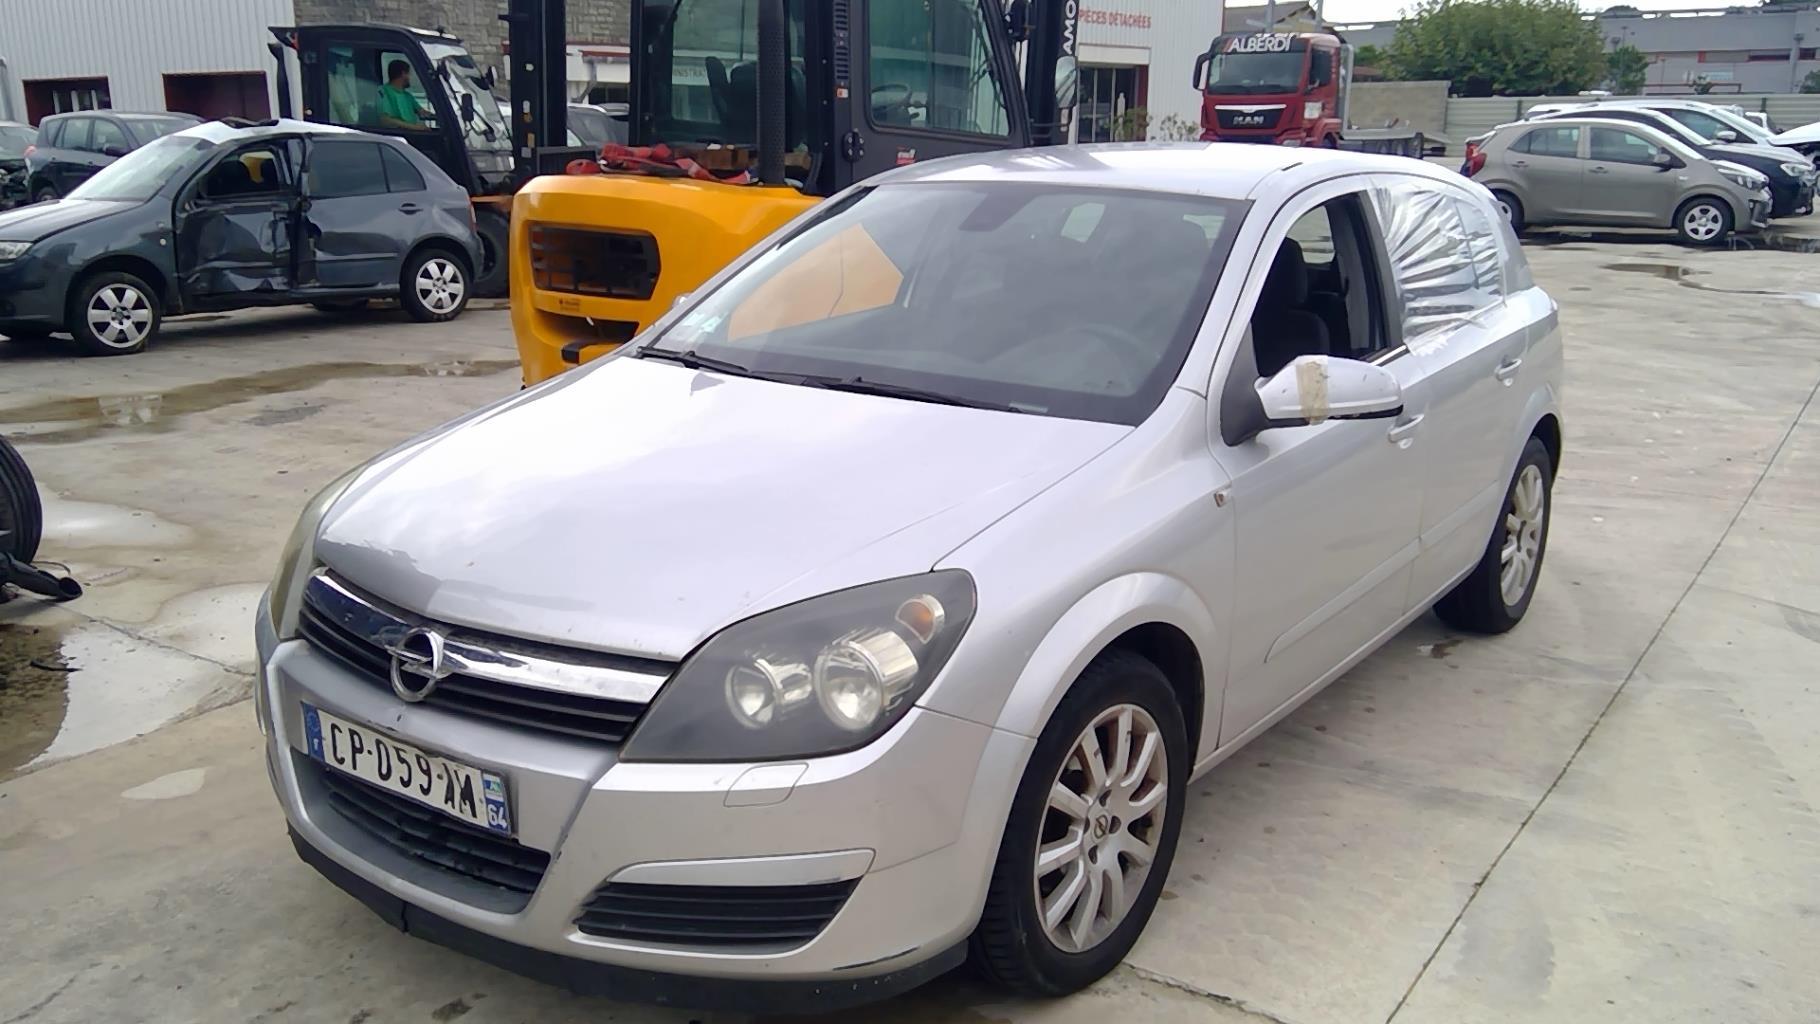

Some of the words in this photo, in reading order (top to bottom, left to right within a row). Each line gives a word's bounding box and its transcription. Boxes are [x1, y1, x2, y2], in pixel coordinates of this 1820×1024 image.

[1228, 36, 1291, 52] ALBERDI
[1233, 116, 1264, 125] MAN
[487, 803, 508, 829] 64
